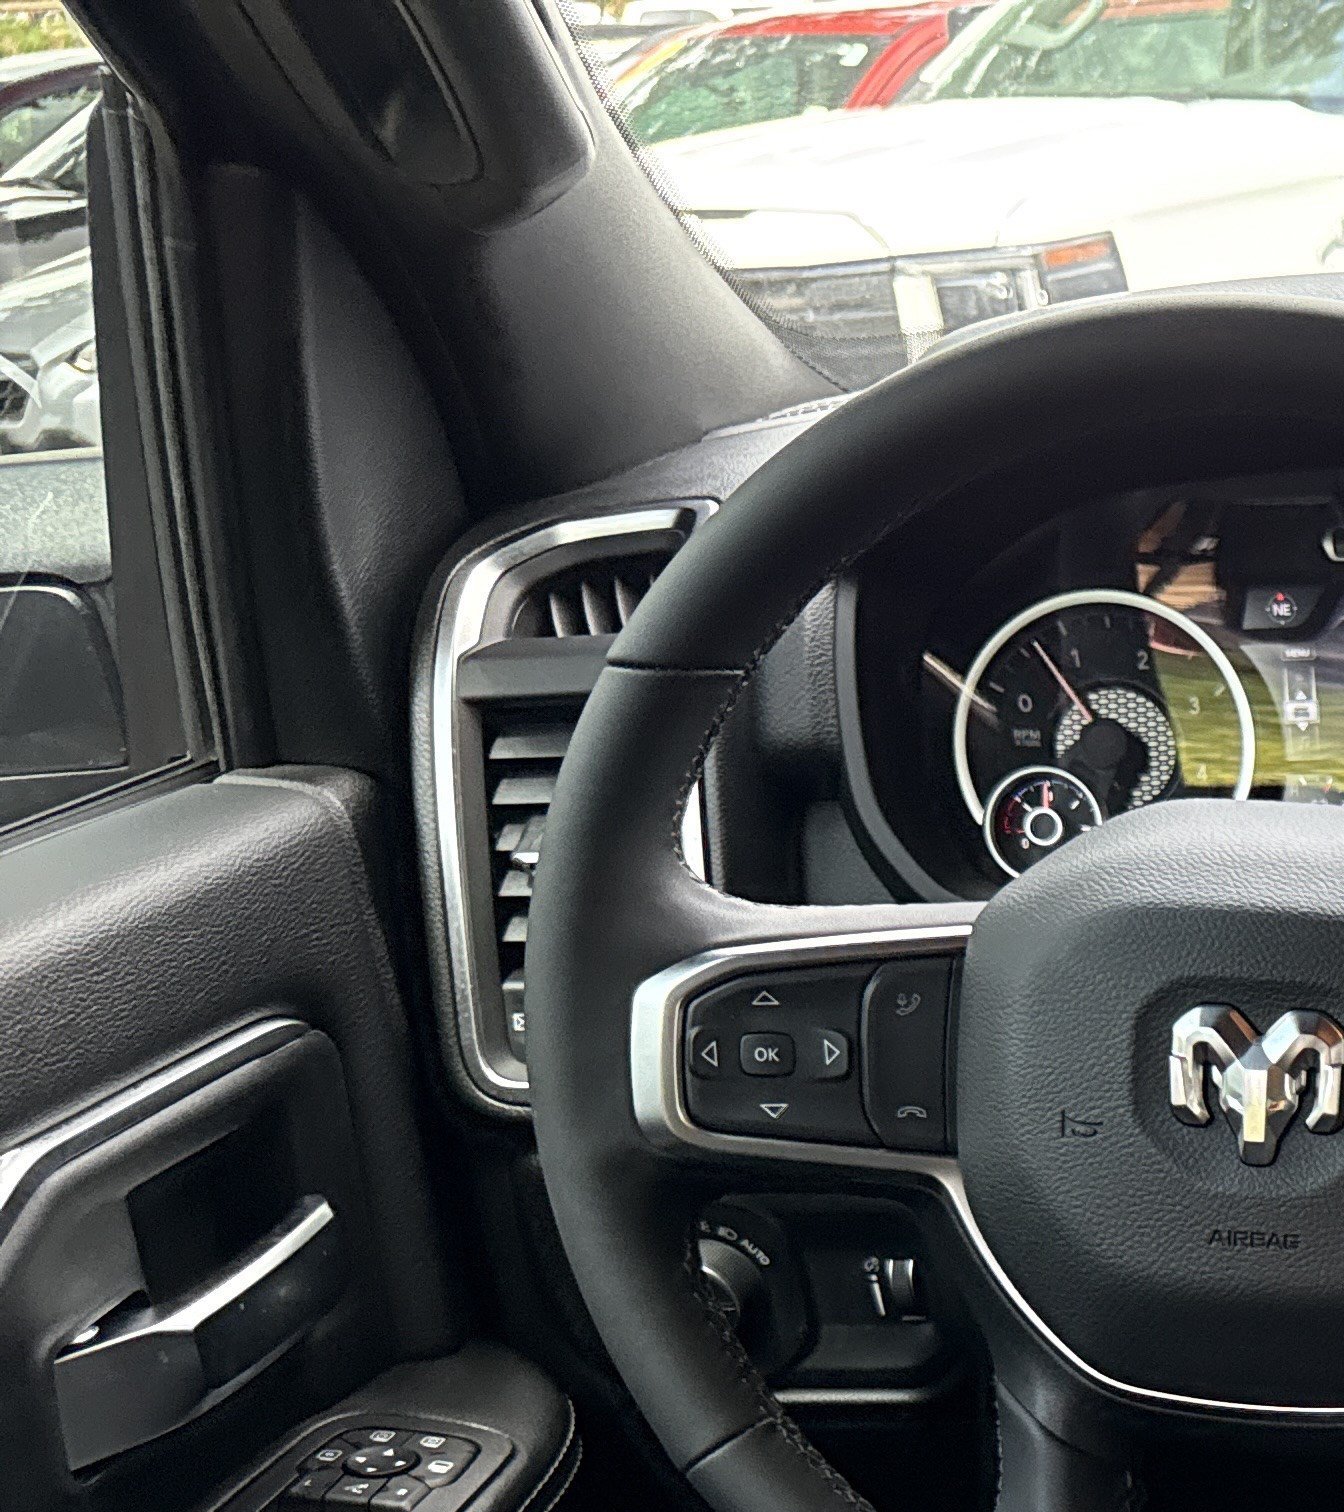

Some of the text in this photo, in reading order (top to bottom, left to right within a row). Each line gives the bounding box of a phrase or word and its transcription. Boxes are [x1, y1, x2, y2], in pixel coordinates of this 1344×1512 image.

[1271, 603, 1292, 617] NE
[1071, 649, 1081, 668] 1
[1137, 651, 1150, 671] 2
[1017, 694, 1033, 713] 0
[1189, 697, 1200, 715] 3
[754, 1047, 780, 1062] OK
[1208, 1228, 1301, 1250] AIRBAG
[740, 1237, 772, 1266] AUTO
